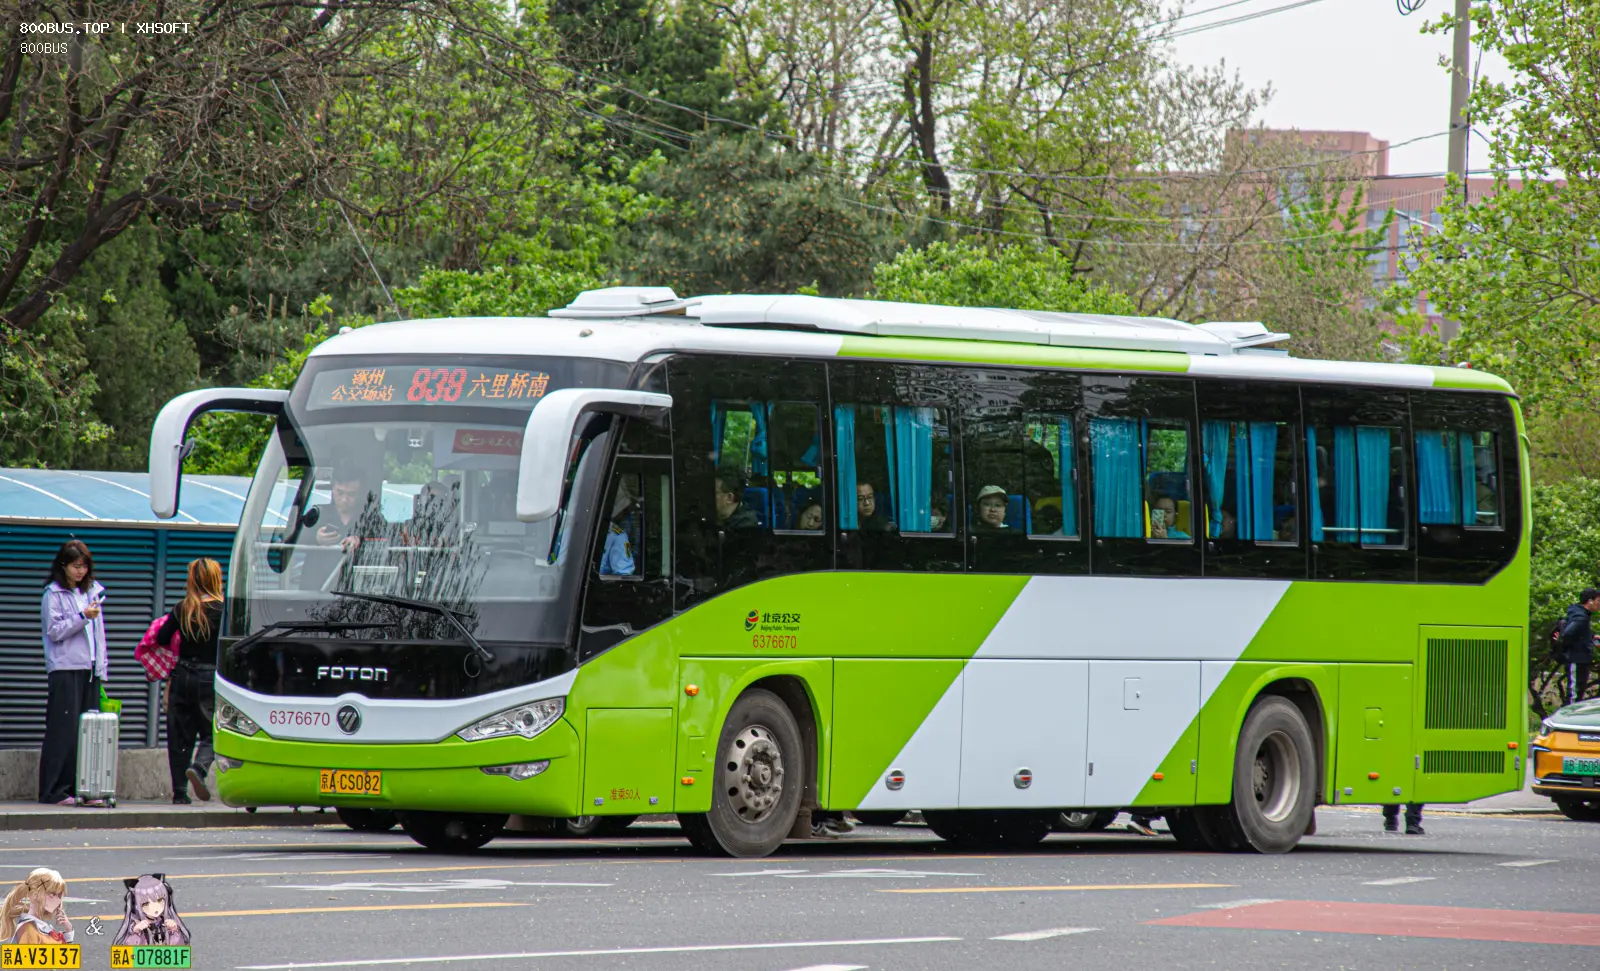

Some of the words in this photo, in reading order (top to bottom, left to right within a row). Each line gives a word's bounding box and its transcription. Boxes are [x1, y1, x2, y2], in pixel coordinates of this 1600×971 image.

[407, 368, 468, 402] 838
[467, 372, 550, 399] 六里桥南
[761, 612, 801, 624] 北京公交
[752, 634, 797, 649] 6376670
[317, 666, 388, 681] FOTON
[269, 710, 331, 727] 6376670
